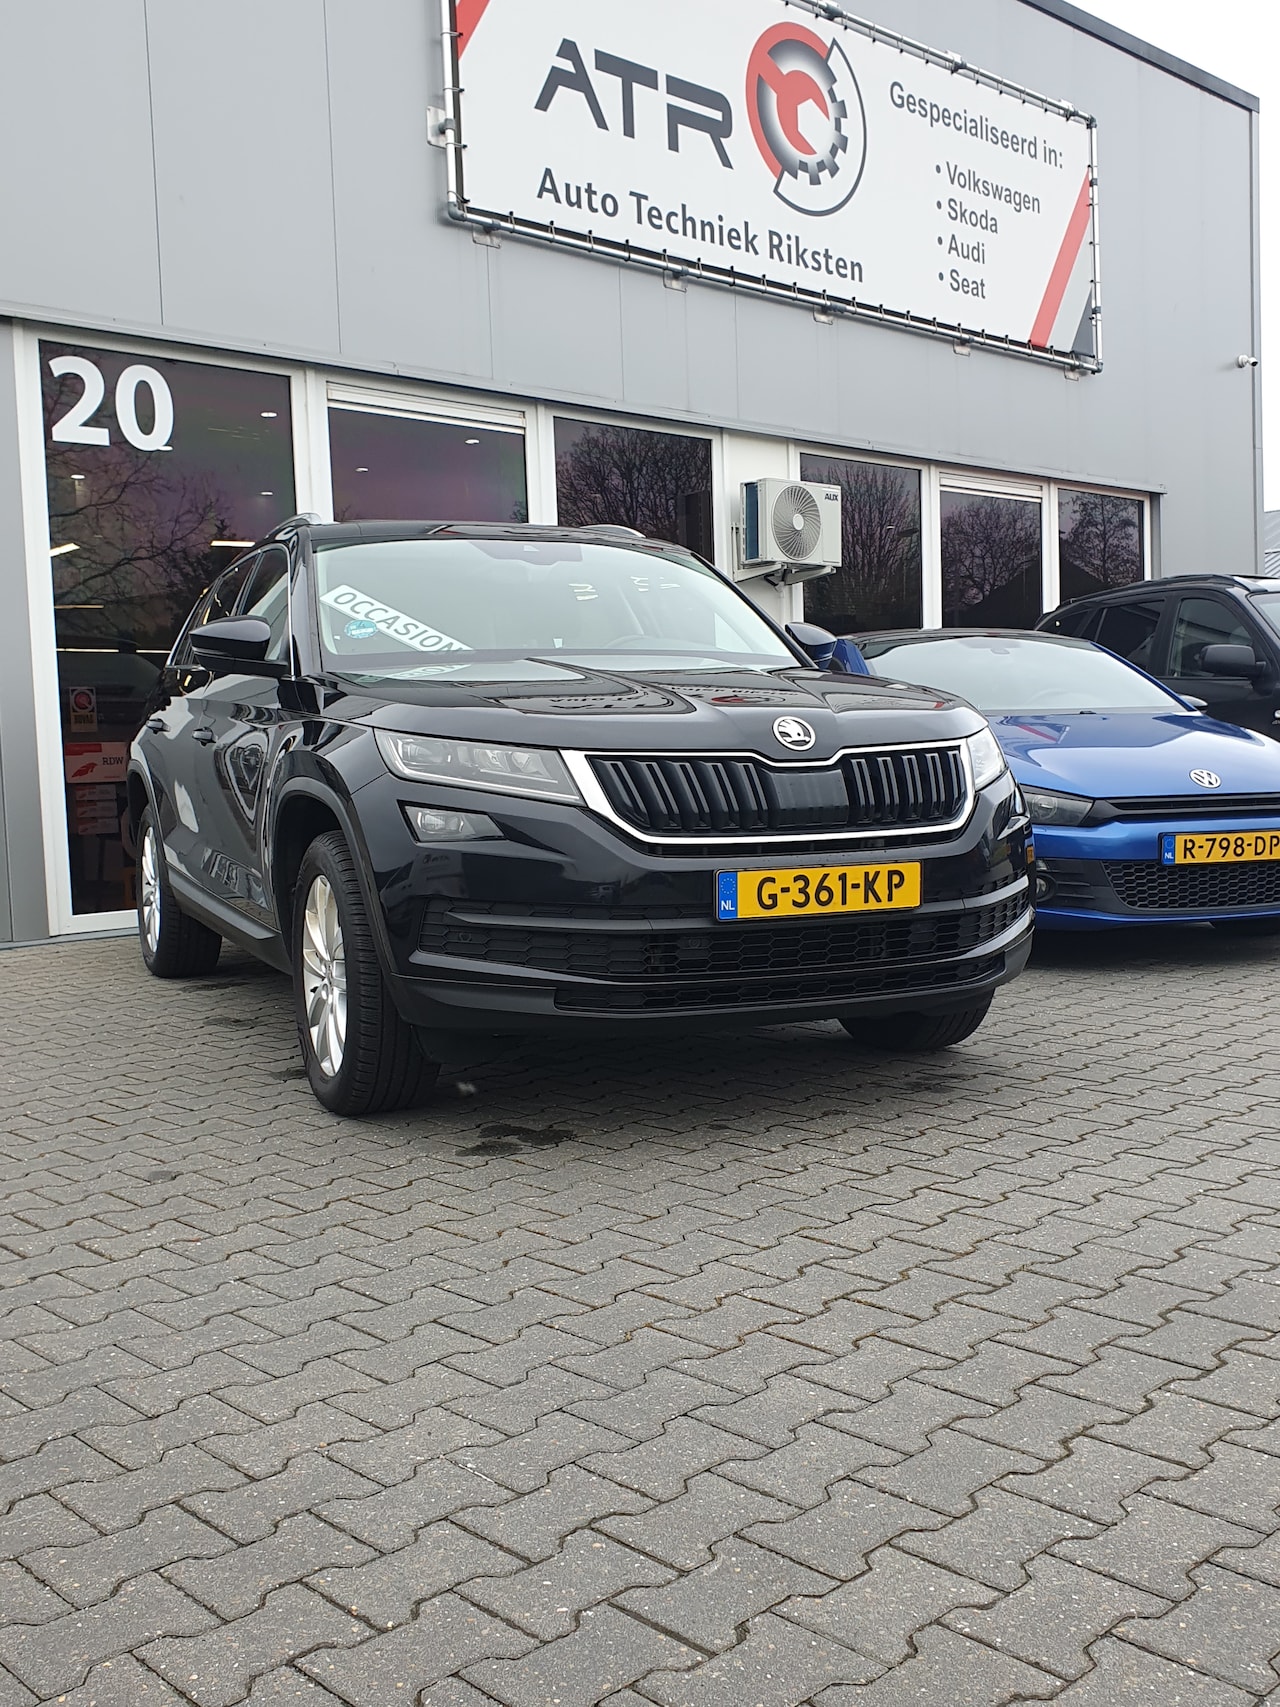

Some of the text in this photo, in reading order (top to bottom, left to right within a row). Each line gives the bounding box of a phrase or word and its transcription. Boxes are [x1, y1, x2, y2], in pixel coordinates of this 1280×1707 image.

[534, 37, 734, 170] ATR
[889, 81, 1063, 169] Gespecialiseerd in:
[946, 160, 1040, 214] Volkswagen
[536, 167, 863, 283] Auto Techniek Riksten
[947, 197, 998, 234] Skoda
[947, 233, 986, 265] Audi
[949, 268, 986, 300] Seat
[48, 355, 174, 451] 20
[824, 493, 839, 502] AUX
[102, 756, 124, 766] RDW
[1164, 835, 1280, 860] NL R-798-DP
[721, 869, 905, 911] NL G-361-KP
